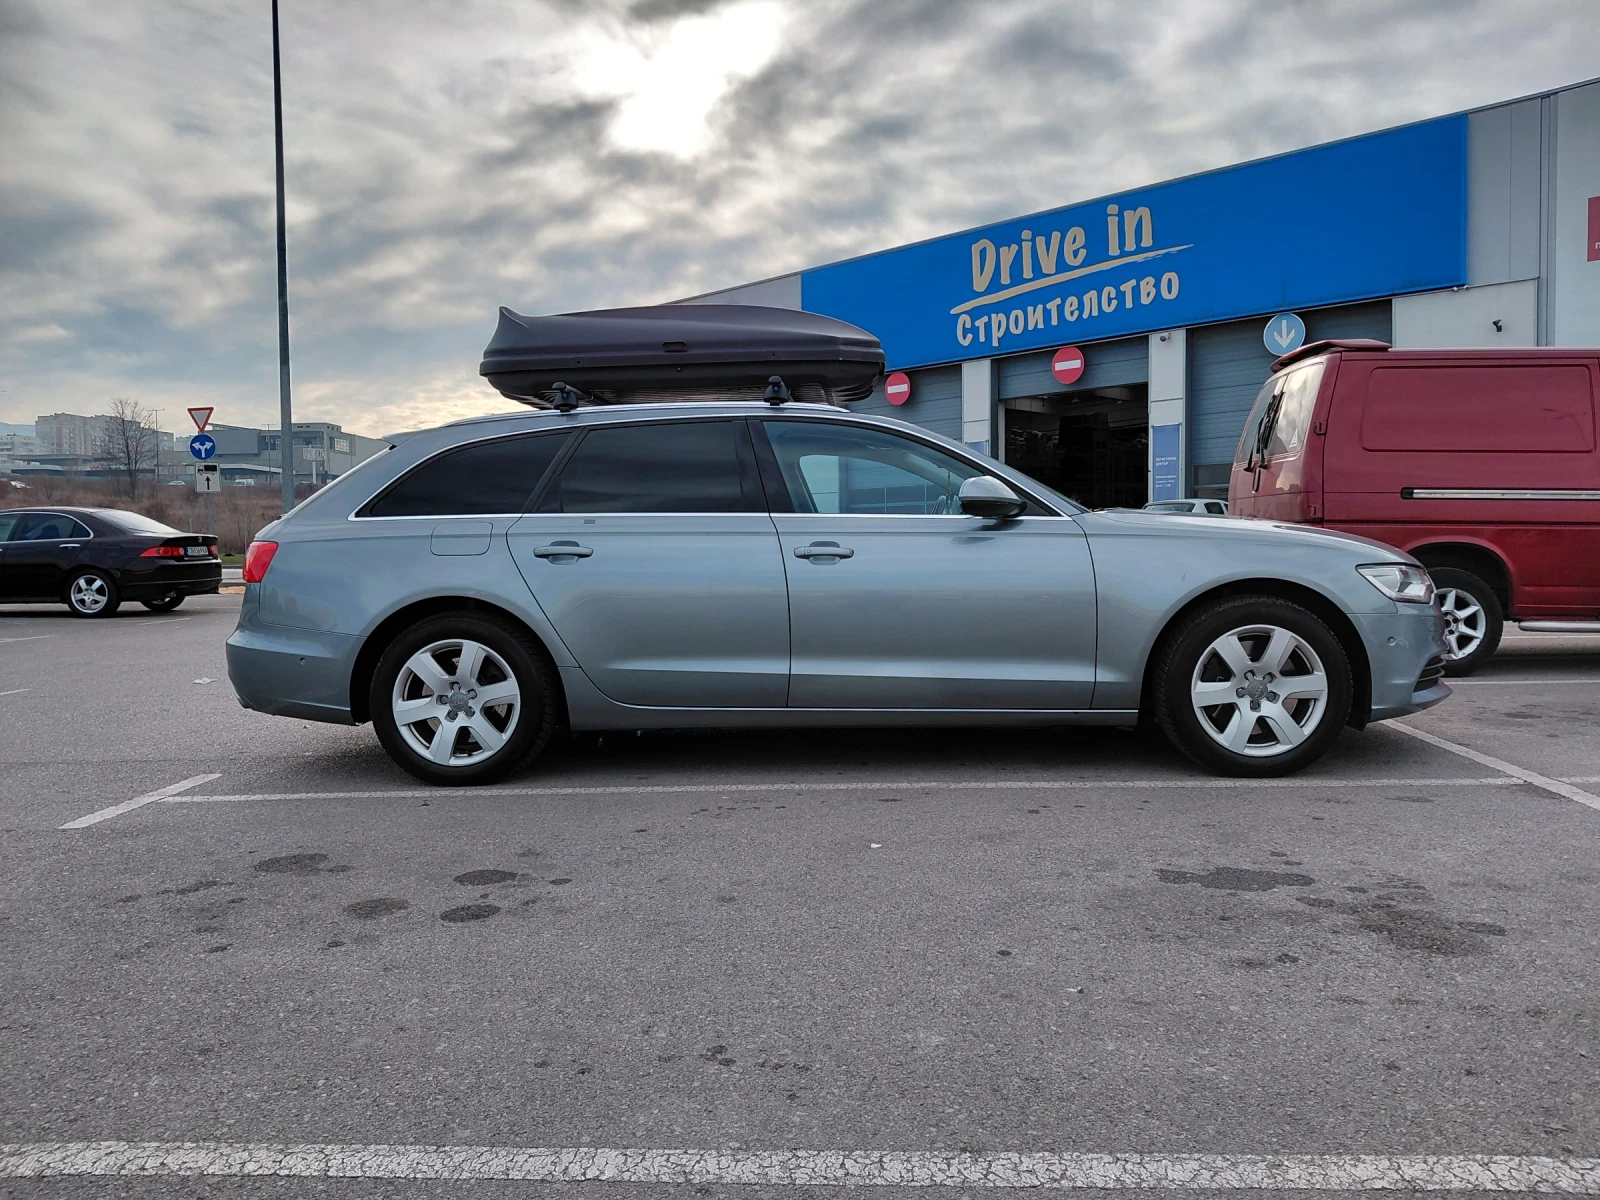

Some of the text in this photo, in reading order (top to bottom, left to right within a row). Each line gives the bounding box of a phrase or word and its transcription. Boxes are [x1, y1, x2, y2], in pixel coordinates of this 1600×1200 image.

[971, 204, 1153, 293] Drive in
[956, 271, 1180, 347] Строителство
